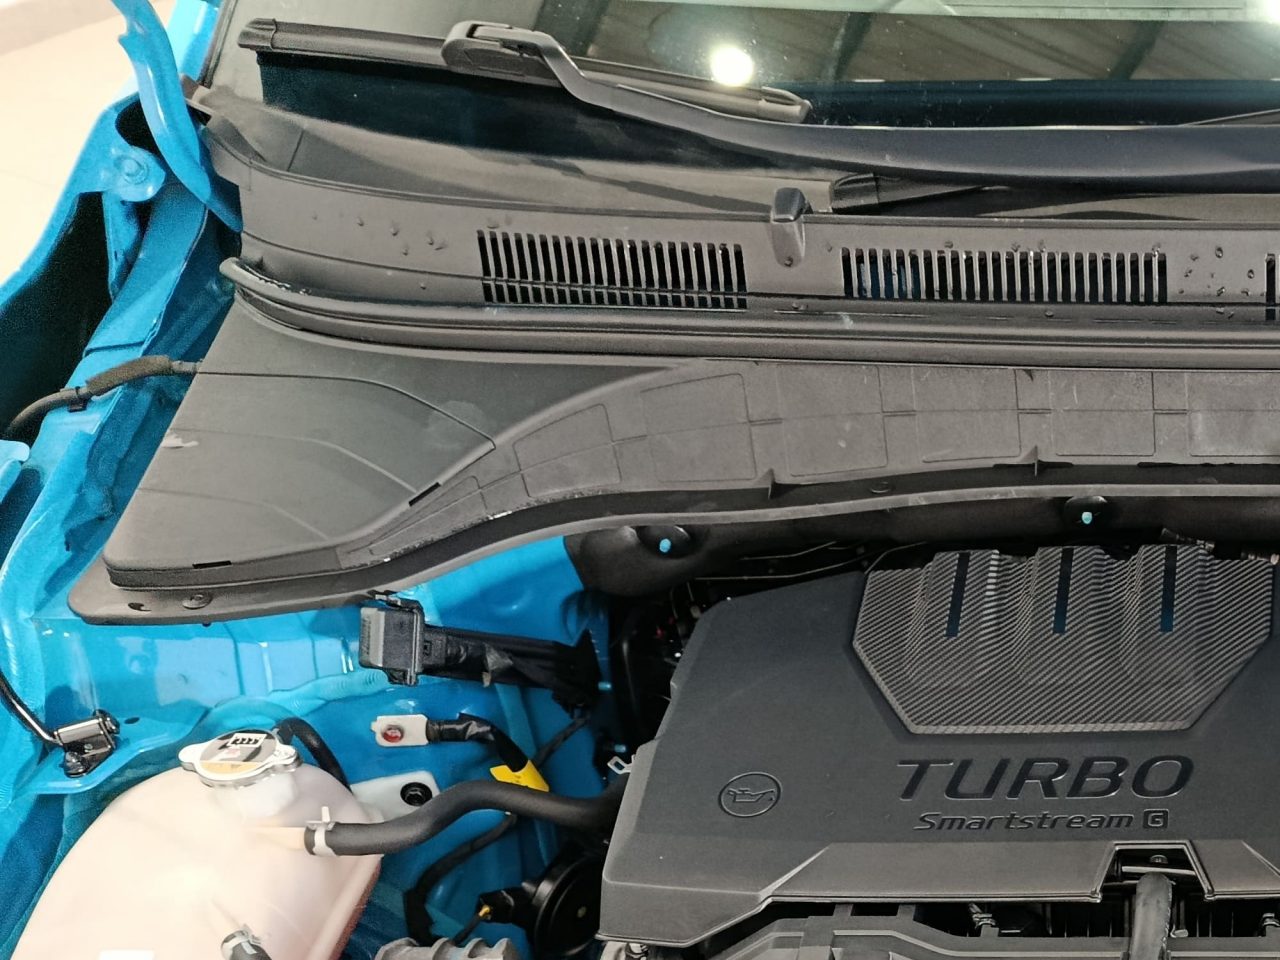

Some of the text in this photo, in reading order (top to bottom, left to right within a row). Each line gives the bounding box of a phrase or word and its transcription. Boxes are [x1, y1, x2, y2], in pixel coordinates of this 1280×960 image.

[897, 754, 1194, 801] TURBO
[913, 809, 1168, 831] Smartstream G
